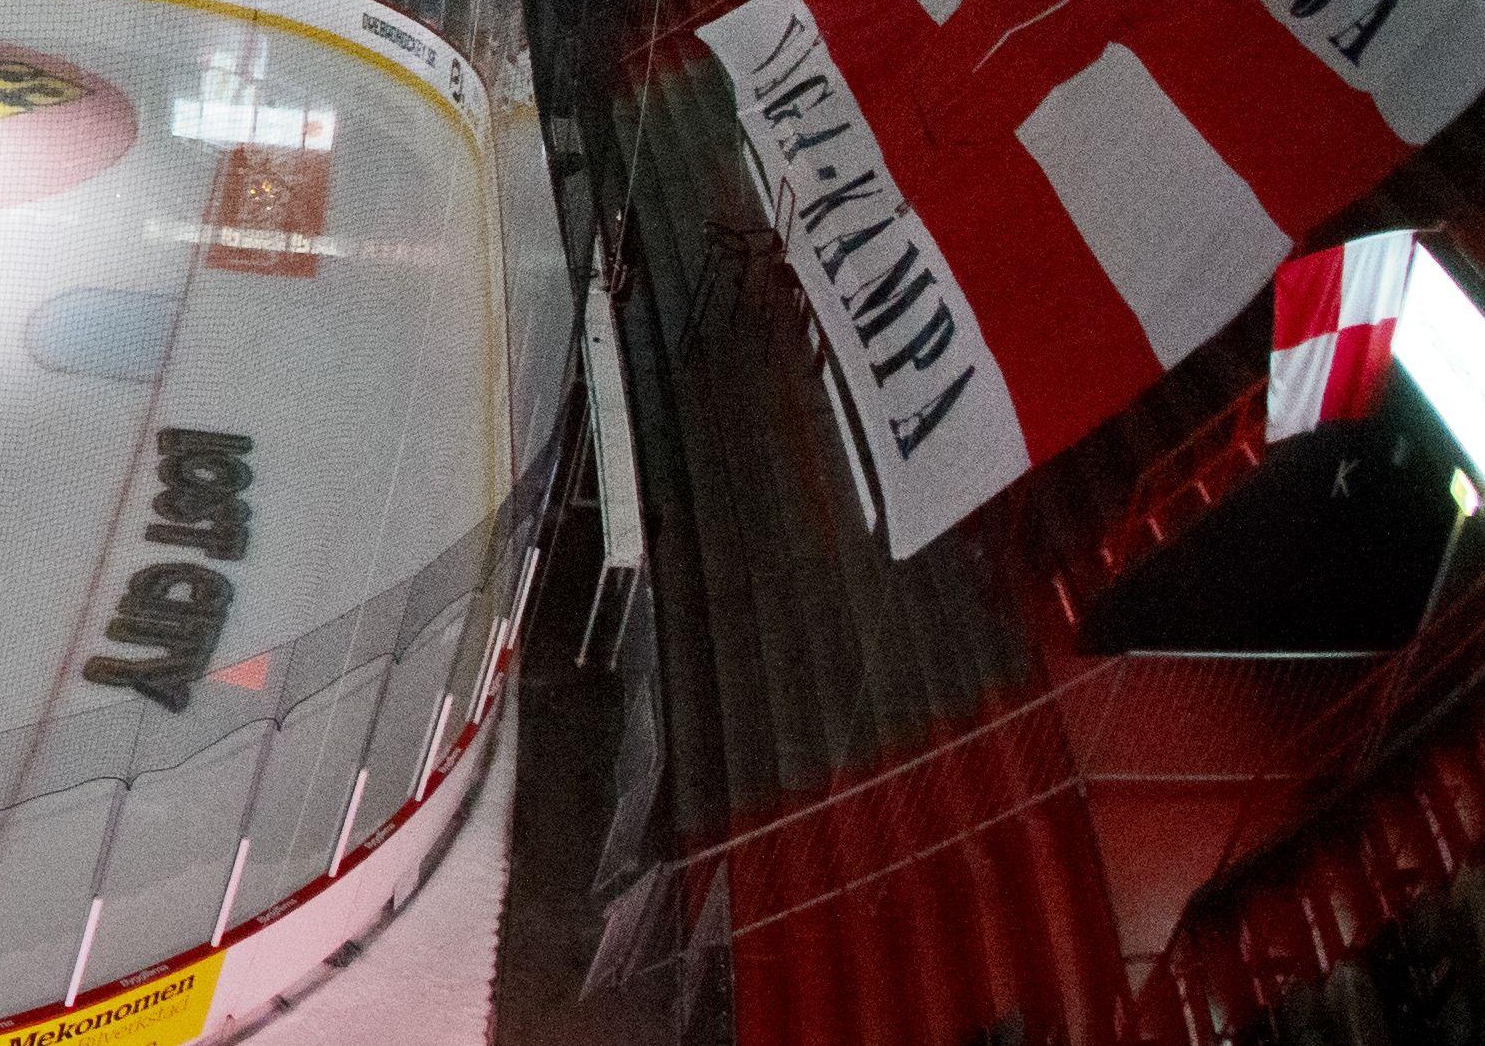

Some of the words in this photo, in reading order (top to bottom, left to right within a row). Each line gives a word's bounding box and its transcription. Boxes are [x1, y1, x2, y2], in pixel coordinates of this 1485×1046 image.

[750, 15, 851, 162] VÅGA
[799, 167, 976, 461] KÄMPA
[143, 426, 254, 562] LOST
[81, 563, 236, 716] CITY
[9, 974, 195, 1046] Mekonomen
